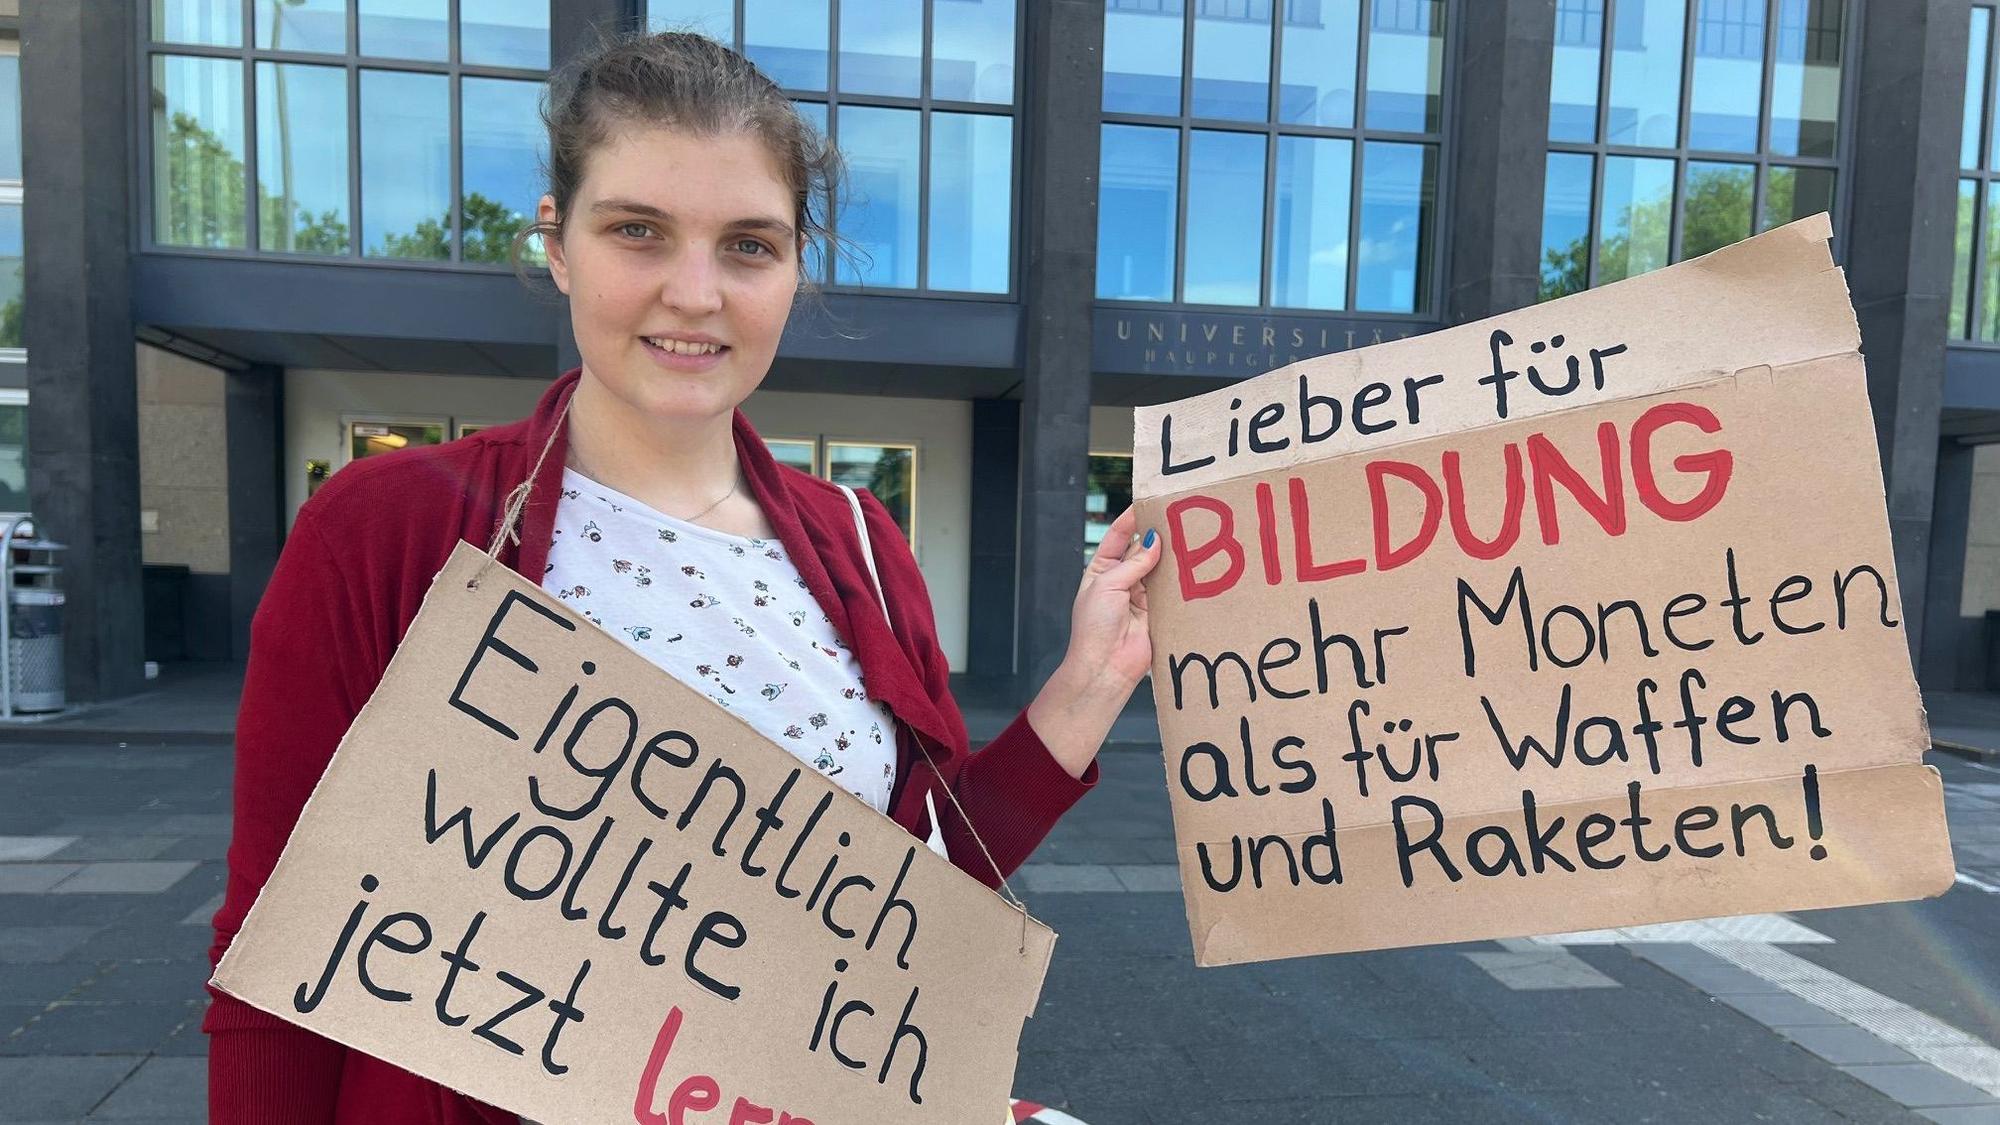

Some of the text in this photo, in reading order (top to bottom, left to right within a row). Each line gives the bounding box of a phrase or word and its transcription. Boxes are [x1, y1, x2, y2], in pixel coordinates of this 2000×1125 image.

[1117, 319, 1408, 349] UNIVERSITÄ
[1162, 330, 1627, 475] Lieber für
[1166, 402, 1734, 602] BILDUNG
[1169, 548, 1898, 710] mehr Moneten
[448, 590, 917, 970] Eigentlich
[1180, 669, 1832, 801] als für Waffen
[1197, 764, 1827, 892] und Raketen!
[294, 875, 591, 1075] jetzt
[425, 769, 927, 1104] wollte ich
